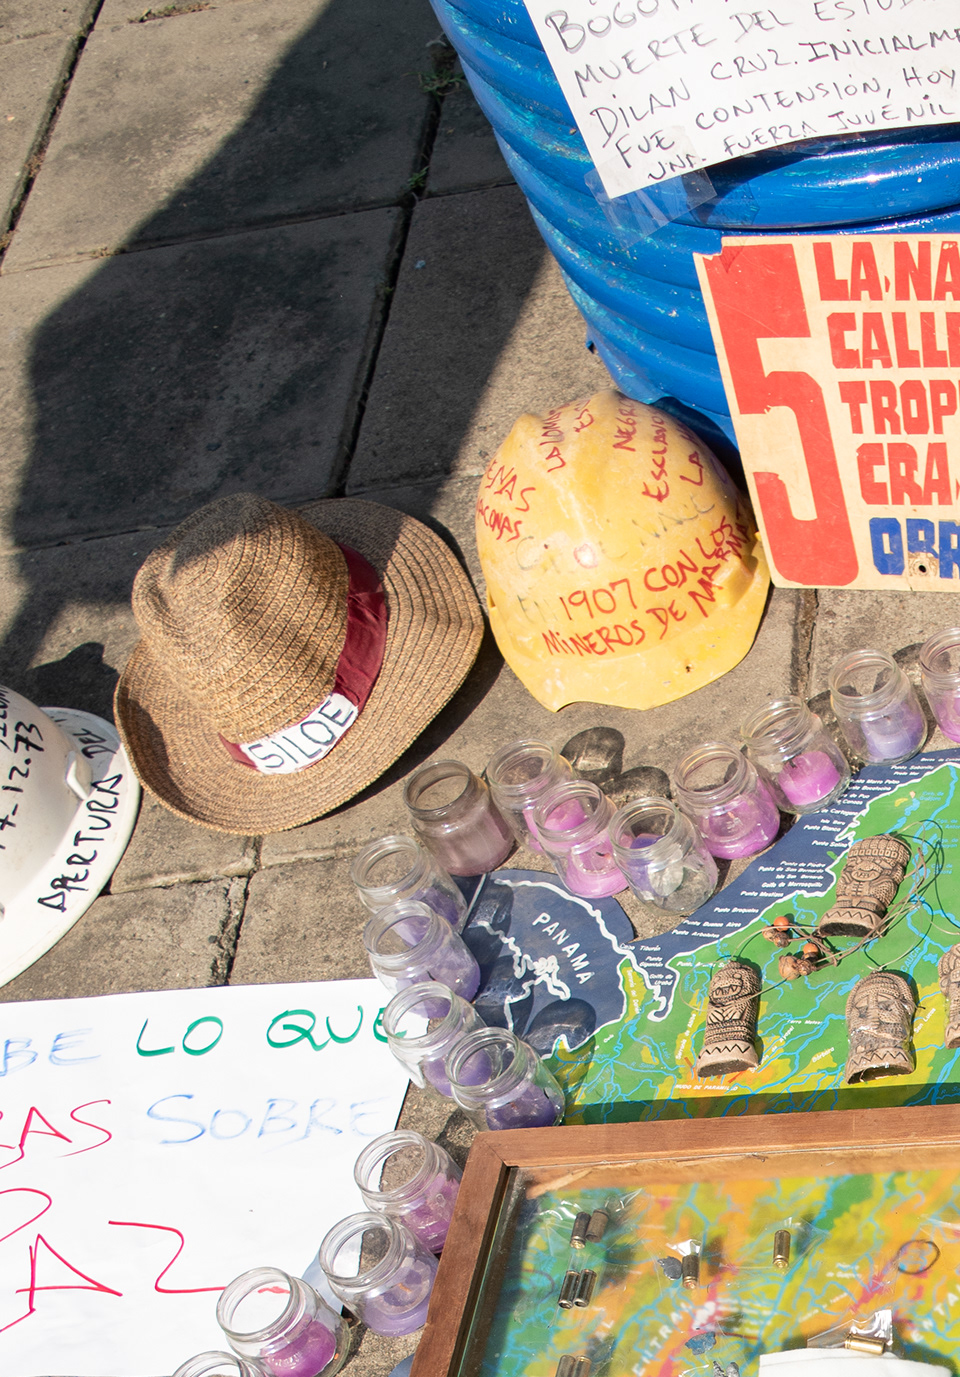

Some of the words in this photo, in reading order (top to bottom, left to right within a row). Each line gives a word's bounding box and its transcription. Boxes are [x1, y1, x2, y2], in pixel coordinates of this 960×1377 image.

[573, 23, 717, 98] MUERTE
[729, 9, 794, 43] DEL
[590, 79, 692, 149] DILAN
[615, 133, 676, 170] FUE
[903, 66, 956, 88] HOY
[827, 94, 956, 131] JUVENIL
[703, 243, 859, 586] 5
[545, 446, 567, 473] LA
[680, 451, 704, 486] LA
[559, 578, 638, 621] 1907
[644, 550, 698, 592] CON
[695, 516, 734, 560] LOS
[542, 619, 647, 657] MINEROS
[646, 599, 687, 640] DE
[247, 700, 355, 769] SILOE
[37, 773, 124, 913] APERTURA
[0, 1028, 102, 1077] BE
[136, 1015, 224, 1057] LO
[266, 1005, 407, 1052] QUE
[0, 1099, 112, 1169] AS
[146, 1093, 391, 1150] SOBRE
